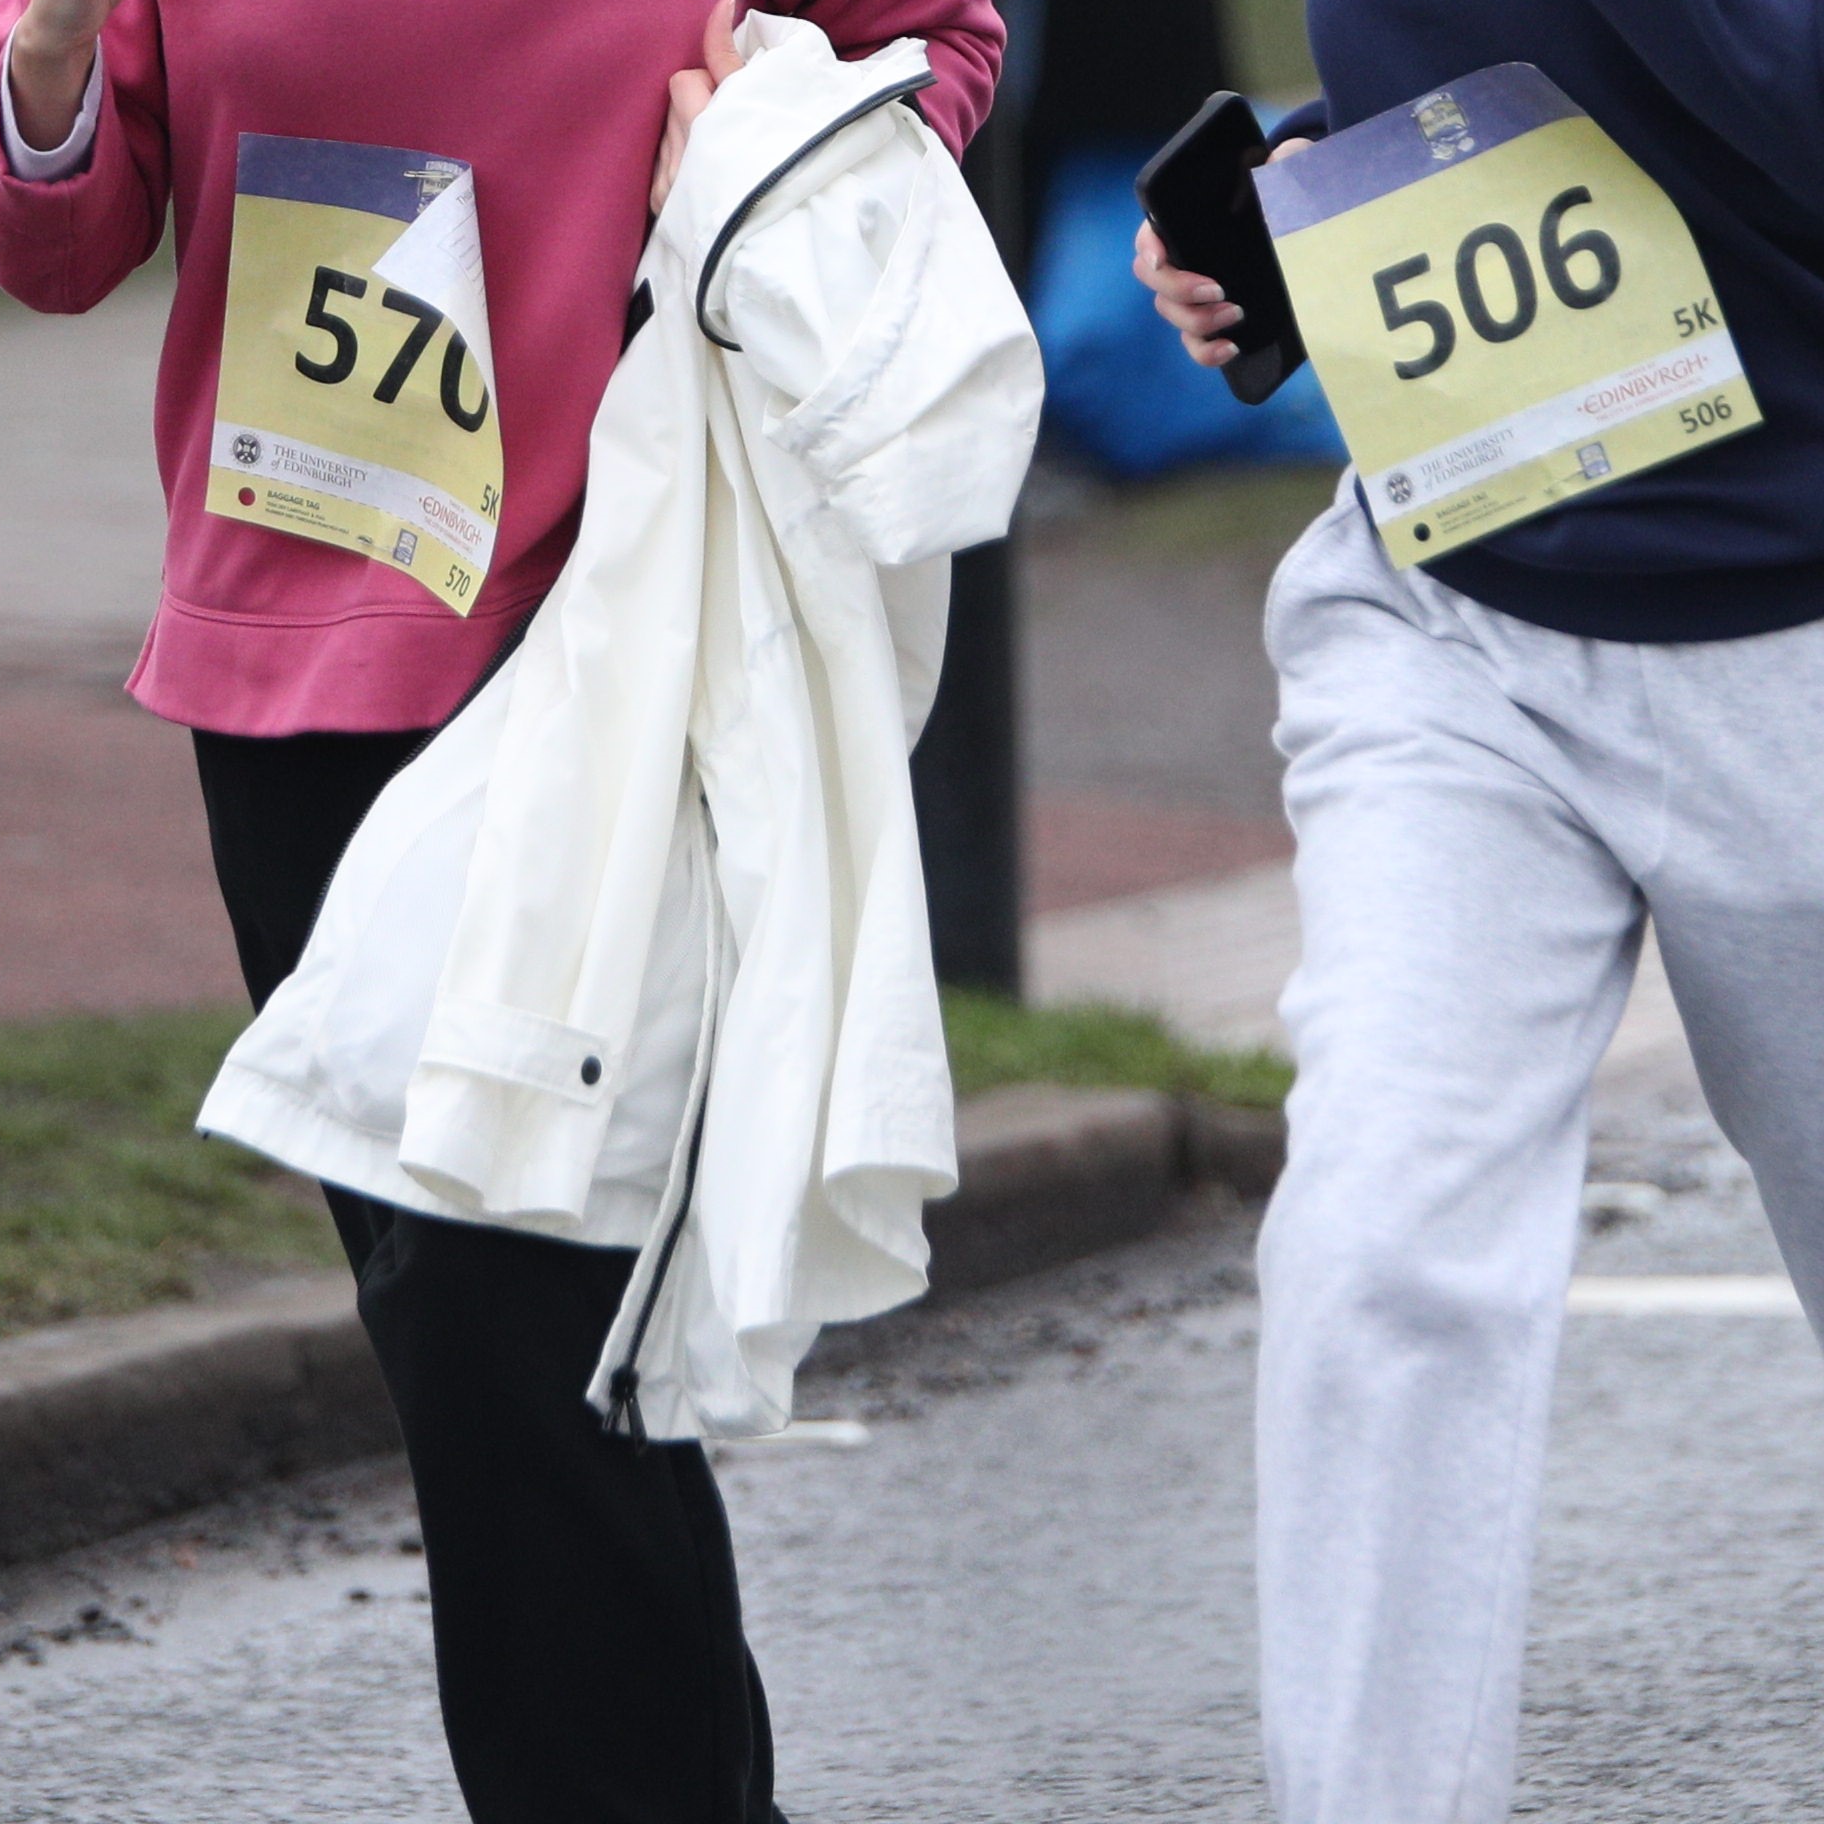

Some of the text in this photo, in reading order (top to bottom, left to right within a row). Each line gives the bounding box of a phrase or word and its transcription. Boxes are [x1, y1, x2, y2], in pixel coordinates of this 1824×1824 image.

[1372, 184, 1622, 381] 506
[1673, 297, 1719, 339] 5K
[295, 265, 491, 433] 570
[1679, 394, 1733, 435] 506
[273, 444, 368, 481] THE UNIVERSITY
[1419, 428, 1516, 476] THE UNIVERSITY
[1435, 446, 1504, 485] EDINBURGH
[271, 457, 352, 489] of EDINBURGH
[480, 484, 500, 520] 5K
[445, 564, 471, 597] 570
